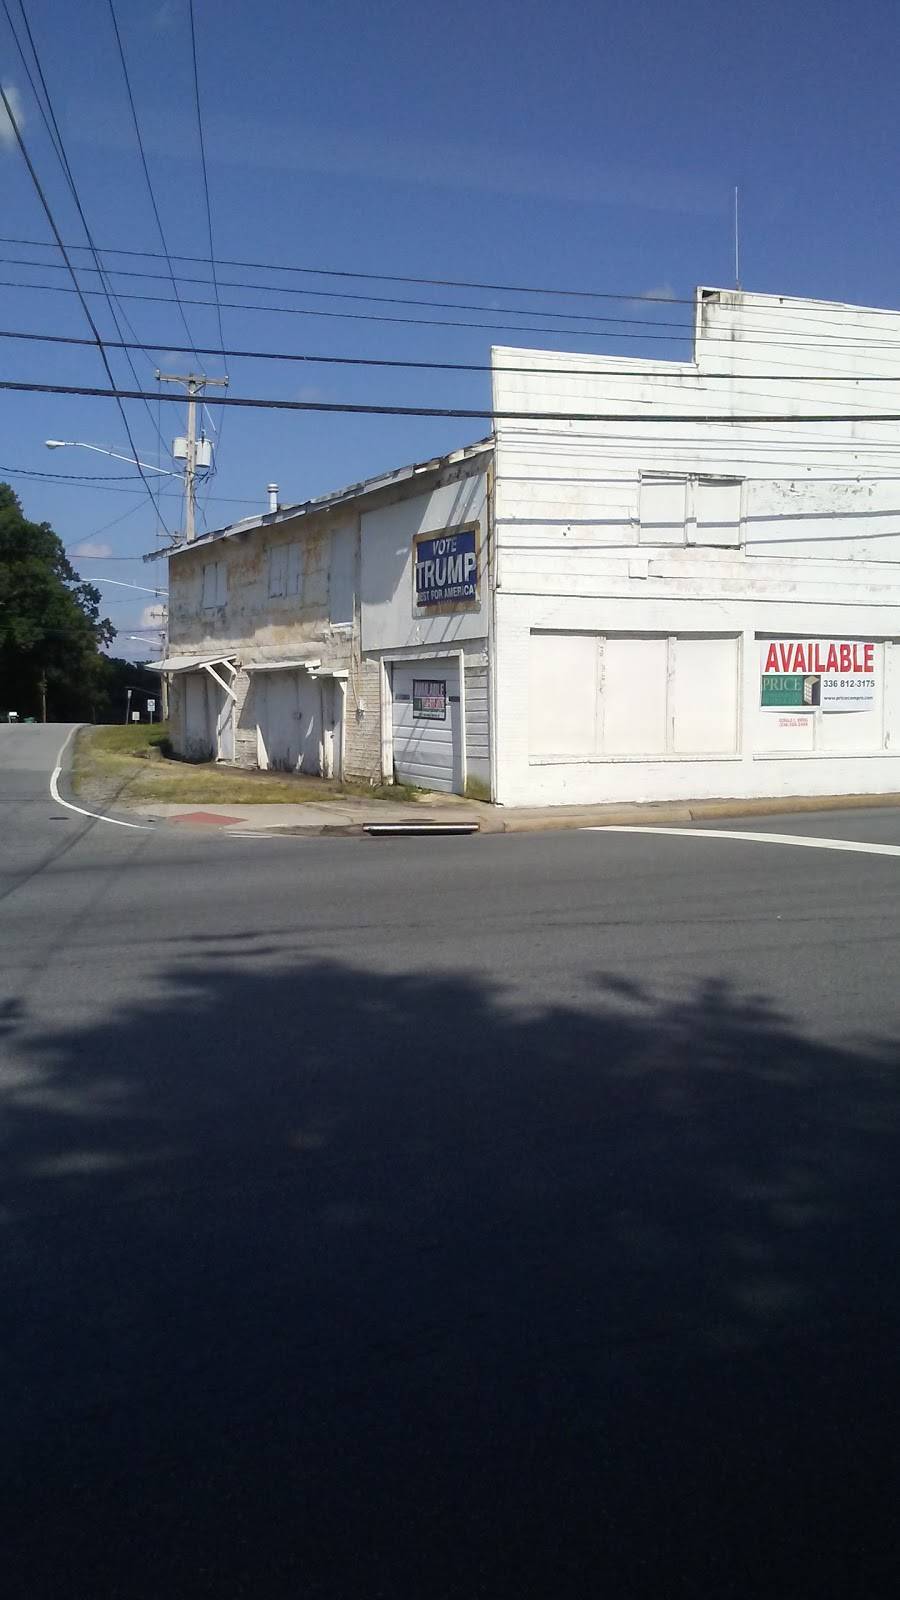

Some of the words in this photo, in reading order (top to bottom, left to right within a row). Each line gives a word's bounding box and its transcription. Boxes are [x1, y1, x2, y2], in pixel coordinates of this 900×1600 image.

[432, 537, 457, 555] VOTE
[416, 552, 476, 589] TRUMP
[430, 589, 443, 600] FOR
[765, 643, 874, 673] AVAILABLE
[762, 677, 803, 691] PRICE
[823, 679, 838, 688] 336
[840, 679, 875, 688] 812-3175
